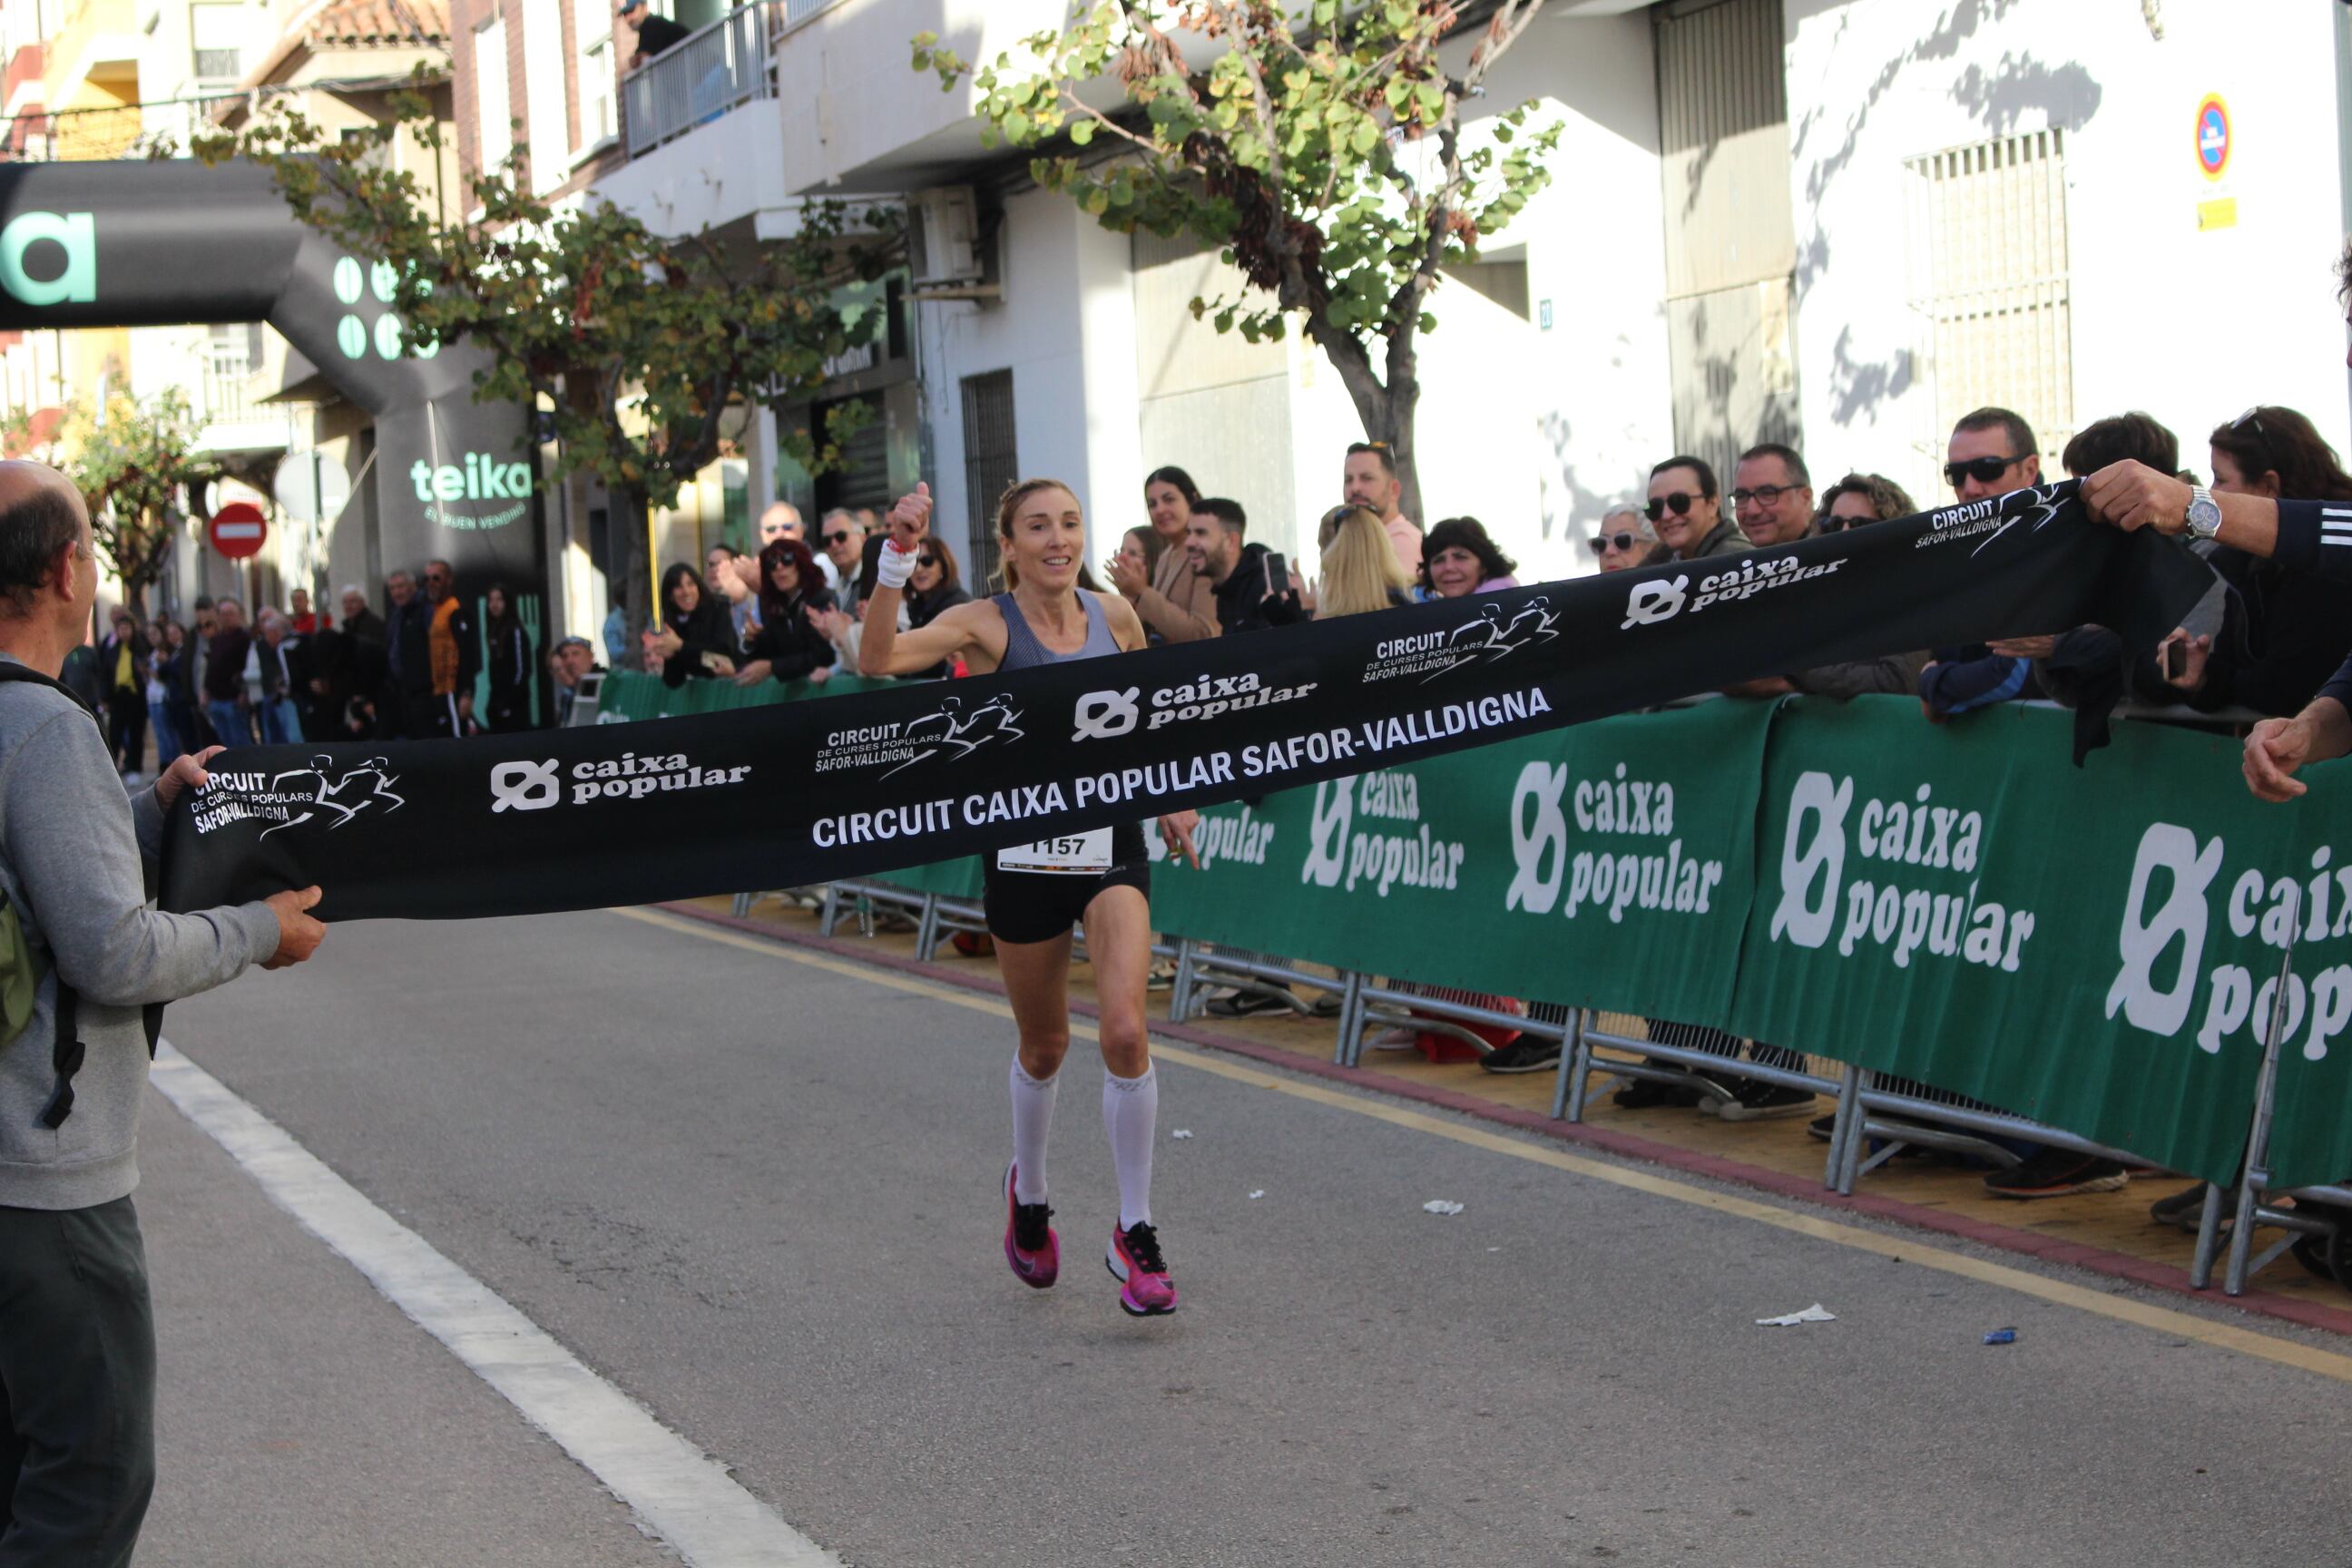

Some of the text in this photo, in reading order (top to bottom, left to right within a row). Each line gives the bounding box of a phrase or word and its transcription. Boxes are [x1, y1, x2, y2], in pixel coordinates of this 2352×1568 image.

[410, 451, 533, 503] teika
[441, 513, 476, 530] BUEN
[478, 501, 526, 529] VENDING
[1915, 515, 2002, 549] SAFOR-VALLDIGNA
[1932, 500, 1993, 530] CIRCUIT
[1690, 558, 1849, 612] popular
[1699, 556, 1798, 593] caixa
[1367, 641, 1484, 671] DE CURSES POPULARS
[1377, 631, 1446, 659] CIRCUIT
[1362, 654, 1456, 683] SAFOR-VALLDIGNA
[1146, 682, 1318, 730] popular
[1152, 672, 1260, 707] caixa
[818, 733, 941, 758] DE CURSES POPULARS
[828, 722, 901, 747] CIRCUIT
[572, 751, 689, 779] caixa
[812, 687, 1553, 848] CIRCUIT CAIXA POPULAR SAFOR-VALLDIGNA
[815, 747, 915, 772] SAFOR-VALLDIGNA
[191, 799, 206, 813] DE
[251, 792, 313, 805] POPULARS
[572, 765, 752, 805] popular
[1360, 768, 1419, 821] caixa
[1574, 762, 1674, 837] caixa
[195, 802, 289, 834] SAFOR-VALLDIGNA
[1859, 783, 1982, 873] caixa
[1171, 806, 1275, 871] opular
[1346, 823, 1465, 897] popular
[1564, 838, 1723, 924] popular
